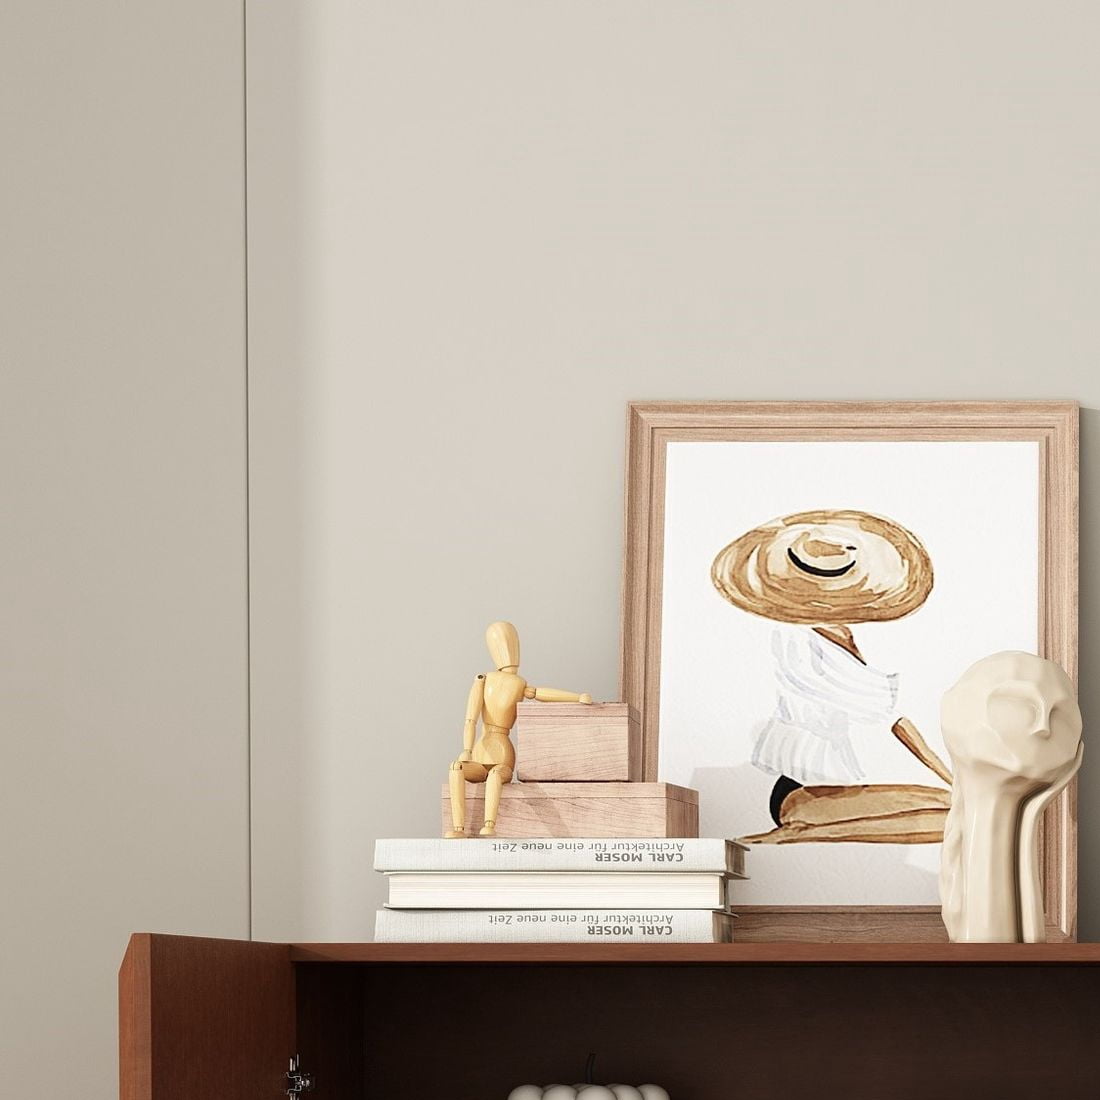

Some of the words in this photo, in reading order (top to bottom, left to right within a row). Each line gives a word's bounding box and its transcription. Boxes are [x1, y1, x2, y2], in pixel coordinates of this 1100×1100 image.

[492, 842, 517, 851] Zeit
[520, 843, 552, 851] neue
[557, 843, 585, 851] eine
[588, 842, 608, 852] für
[610, 842, 685, 852] Architektur
[595, 852, 643, 862] MOSER
[648, 852, 684, 862] CARL
[488, 914, 513, 925] Zeit
[516, 915, 548, 924] neue
[551, 915, 577, 924] eine
[580, 914, 600, 925] für
[603, 914, 673, 925] Architektur
[587, 925, 634, 935] MOSER
[638, 925, 673, 936] CARL
